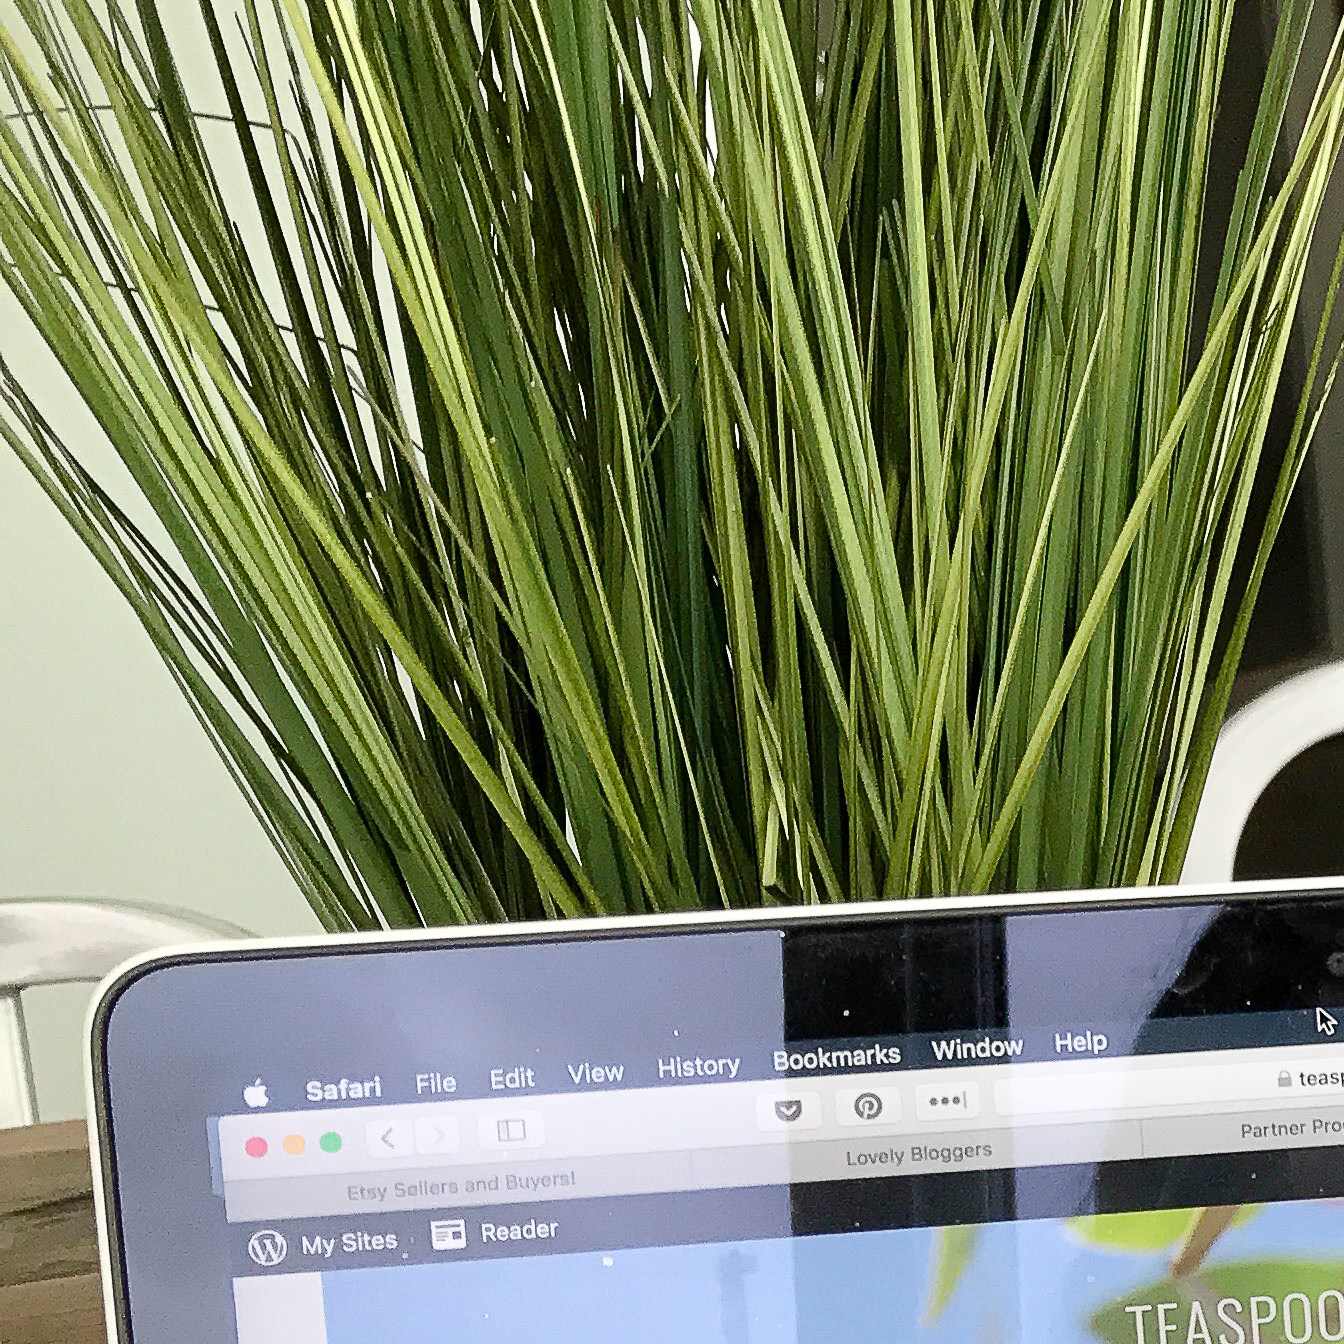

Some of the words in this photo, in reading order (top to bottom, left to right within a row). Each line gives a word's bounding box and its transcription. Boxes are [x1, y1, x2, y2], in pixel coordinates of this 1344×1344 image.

[306, 1077, 382, 1101] Safari
[415, 1073, 456, 1095] File
[490, 1066, 535, 1090] Edit
[567, 1062, 624, 1083] View
[657, 1054, 740, 1081] History
[774, 1044, 901, 1072] Bookmarks
[932, 1035, 1023, 1061] Window
[1055, 1031, 1107, 1056] Help
[1241, 1120, 1307, 1139] Partner
[847, 1148, 905, 1168] Lovely
[911, 1142, 992, 1166] Bloggers
[347, 1184, 386, 1203] Etsy
[392, 1179, 459, 1197] Sellers
[465, 1176, 501, 1193] and
[506, 1170, 576, 1192] Buyers!
[302, 1234, 336, 1257] My
[342, 1230, 397, 1252] Sites
[481, 1219, 559, 1243] Reader
